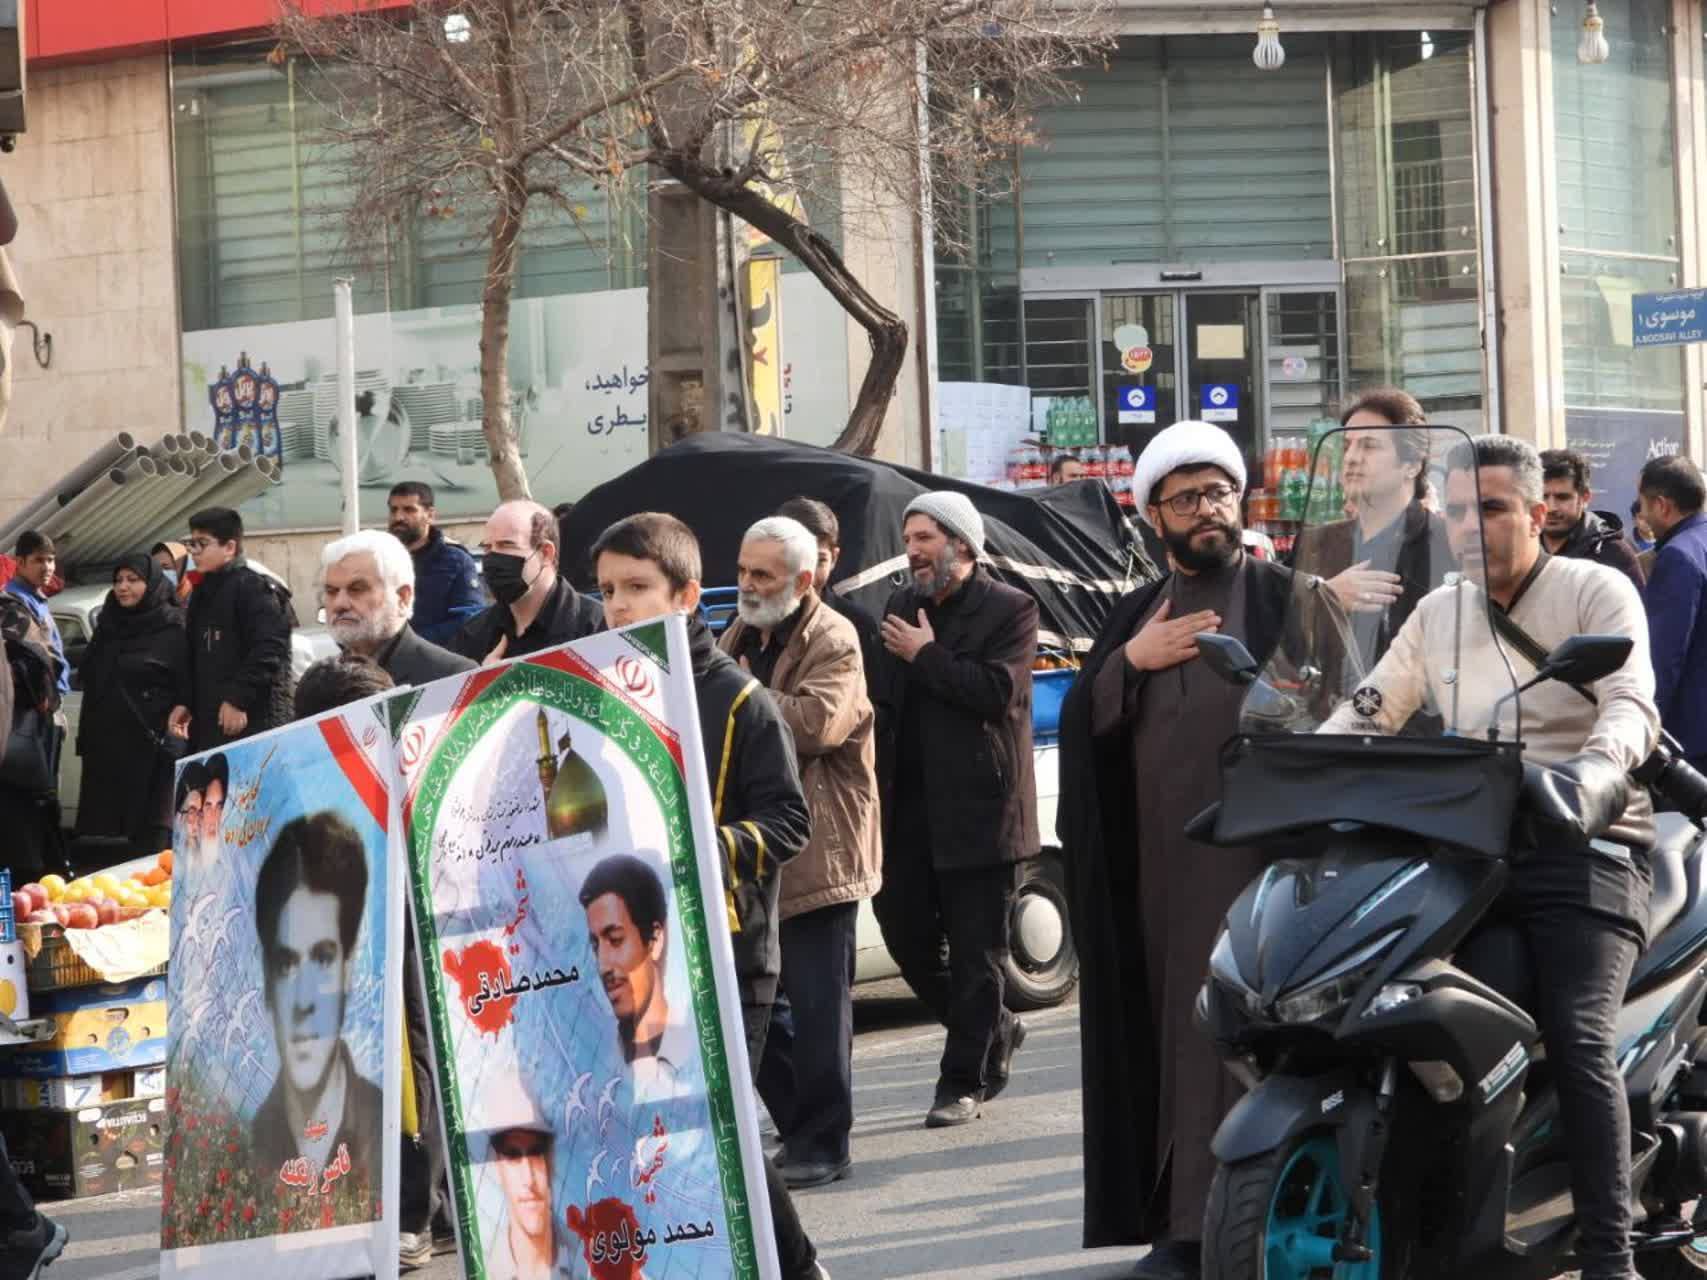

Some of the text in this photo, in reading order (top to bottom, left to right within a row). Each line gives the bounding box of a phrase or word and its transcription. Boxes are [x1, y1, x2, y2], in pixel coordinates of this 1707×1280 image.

[1645, 308, 1696, 328] موسوی
[590, 1217, 715, 1265] محمد مولوی
